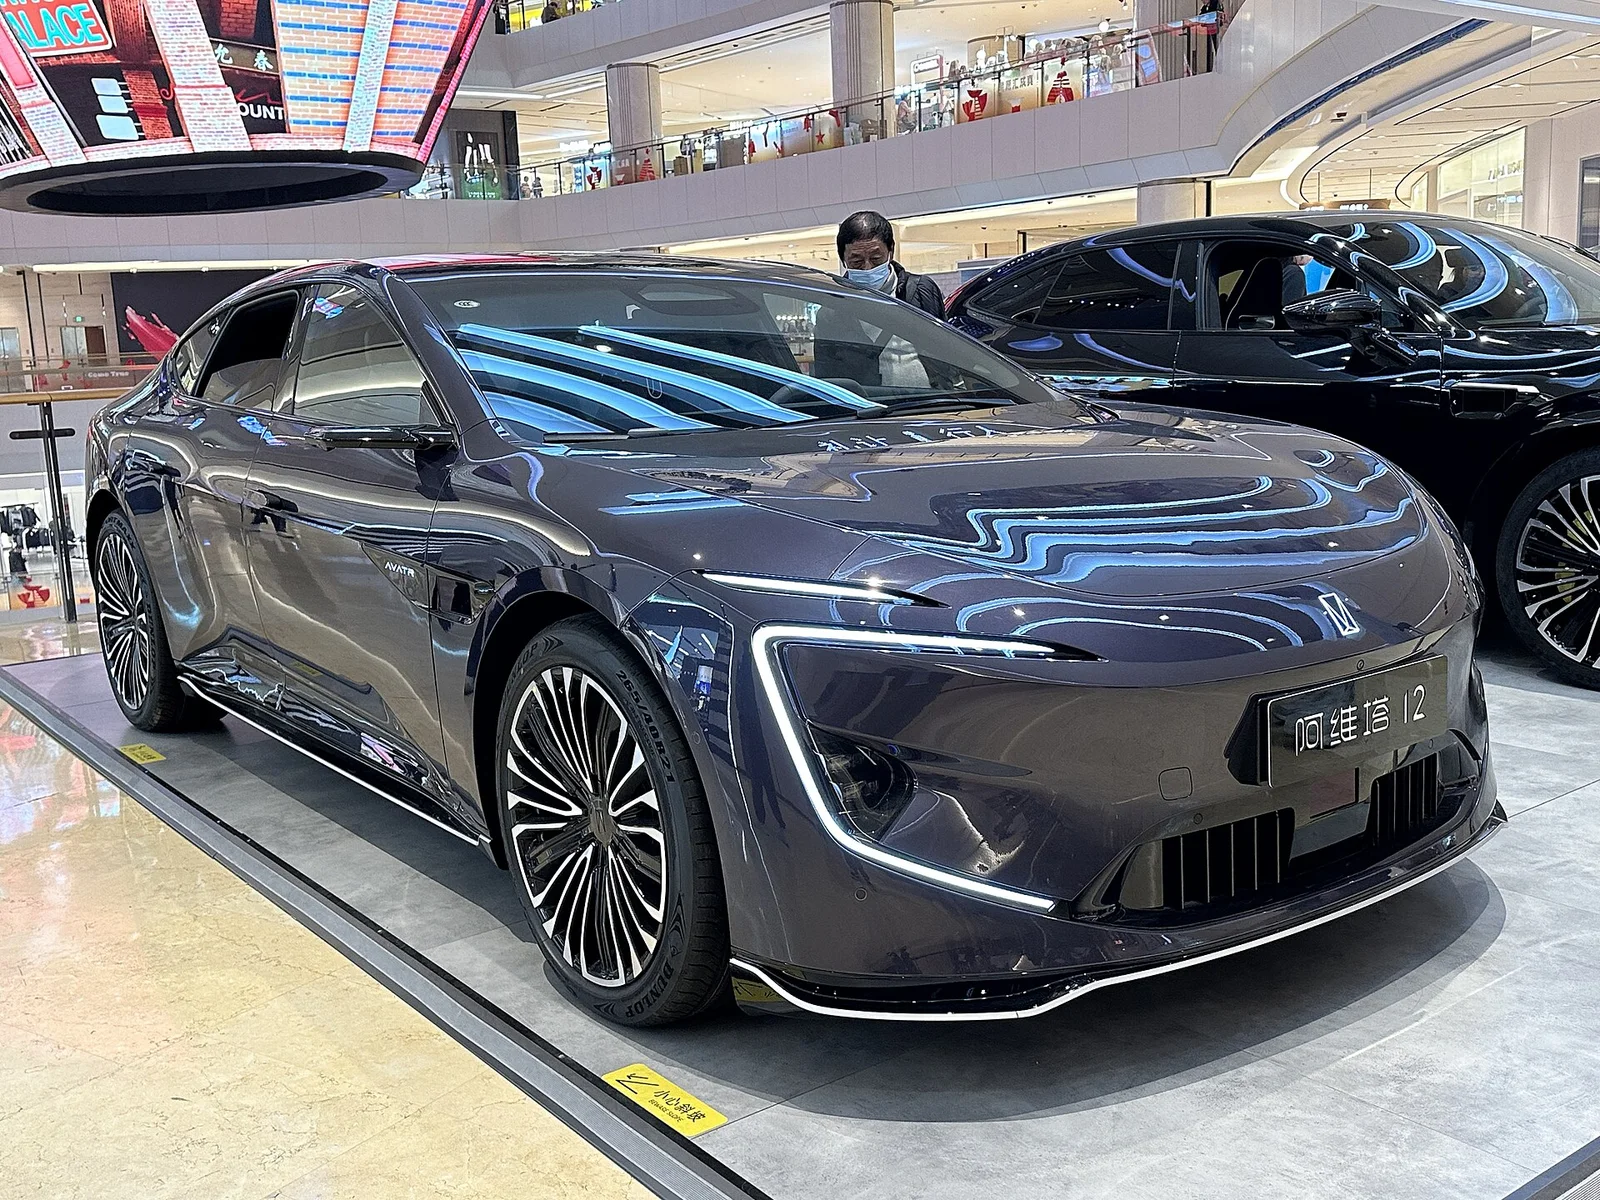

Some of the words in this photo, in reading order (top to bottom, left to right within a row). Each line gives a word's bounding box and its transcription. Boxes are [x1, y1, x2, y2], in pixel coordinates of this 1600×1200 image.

[384, 561, 415, 578] AVATR
[615, 670, 676, 783] 265/40R21
[1295, 694, 1390, 757] 阿维塔
[1402, 684, 1427, 724] 12
[625, 960, 675, 1018] DUNLOP
[653, 1089, 706, 1123] 小心斜坡
